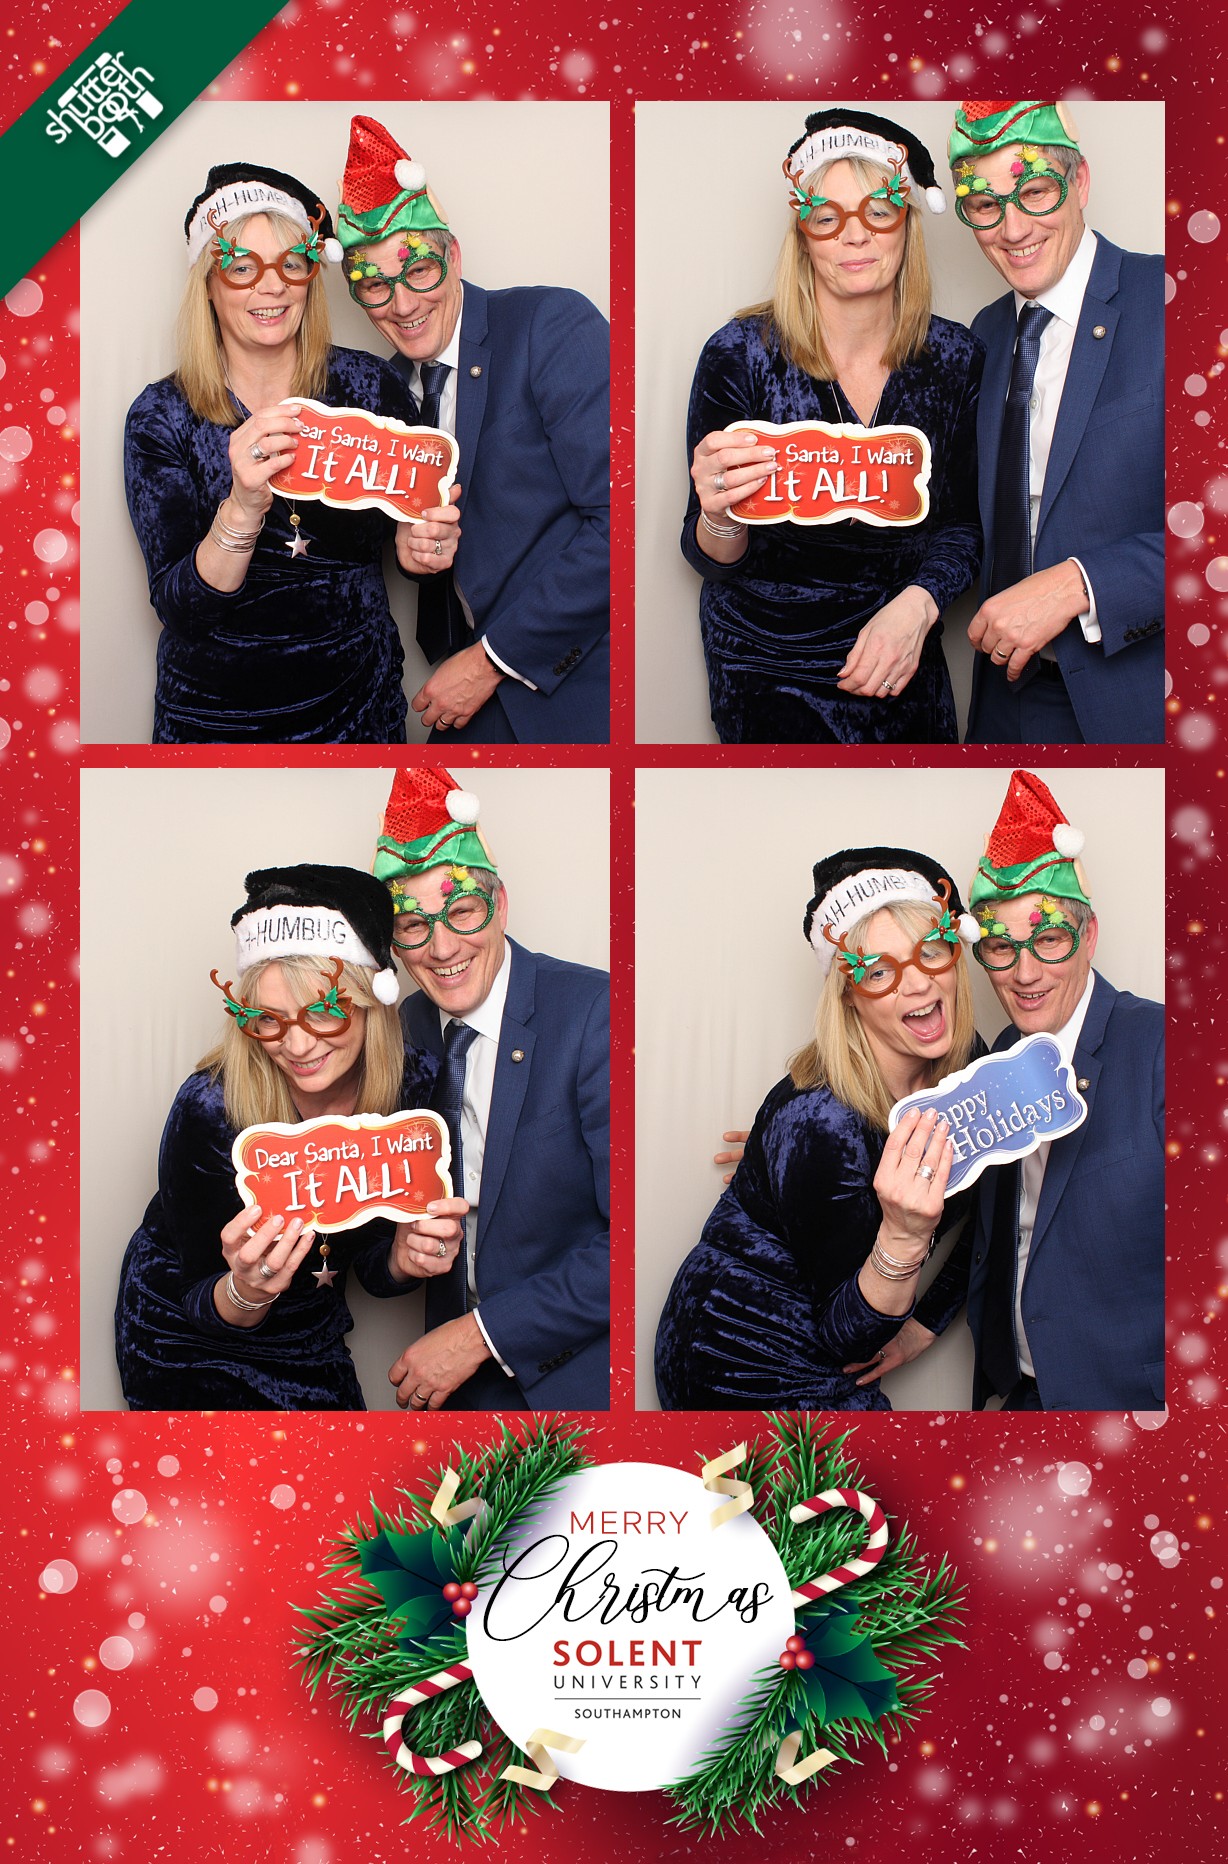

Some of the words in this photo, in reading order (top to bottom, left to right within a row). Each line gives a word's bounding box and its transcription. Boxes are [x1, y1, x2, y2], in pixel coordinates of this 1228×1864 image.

[300, 424, 327, 441] ear
[330, 426, 382, 456] Santa,
[387, 439, 399, 457] I
[403, 443, 444, 467] Want
[785, 443, 845, 466] Santa,
[851, 445, 862, 464] I
[867, 446, 914, 466] Want
[301, 445, 337, 483] It
[345, 453, 417, 499] ALL!
[763, 466, 803, 502] It
[812, 467, 888, 503] ALL!
[937, 1090, 988, 1130] appy
[946, 1089, 1067, 1164] Holidays
[254, 1148, 298, 1169] Dear
[304, 1142, 365, 1164] Santa,
[371, 1135, 382, 1157] I
[386, 1132, 434, 1154] Want
[283, 1170, 325, 1211] It
[335, 1158, 412, 1203] ALL!
